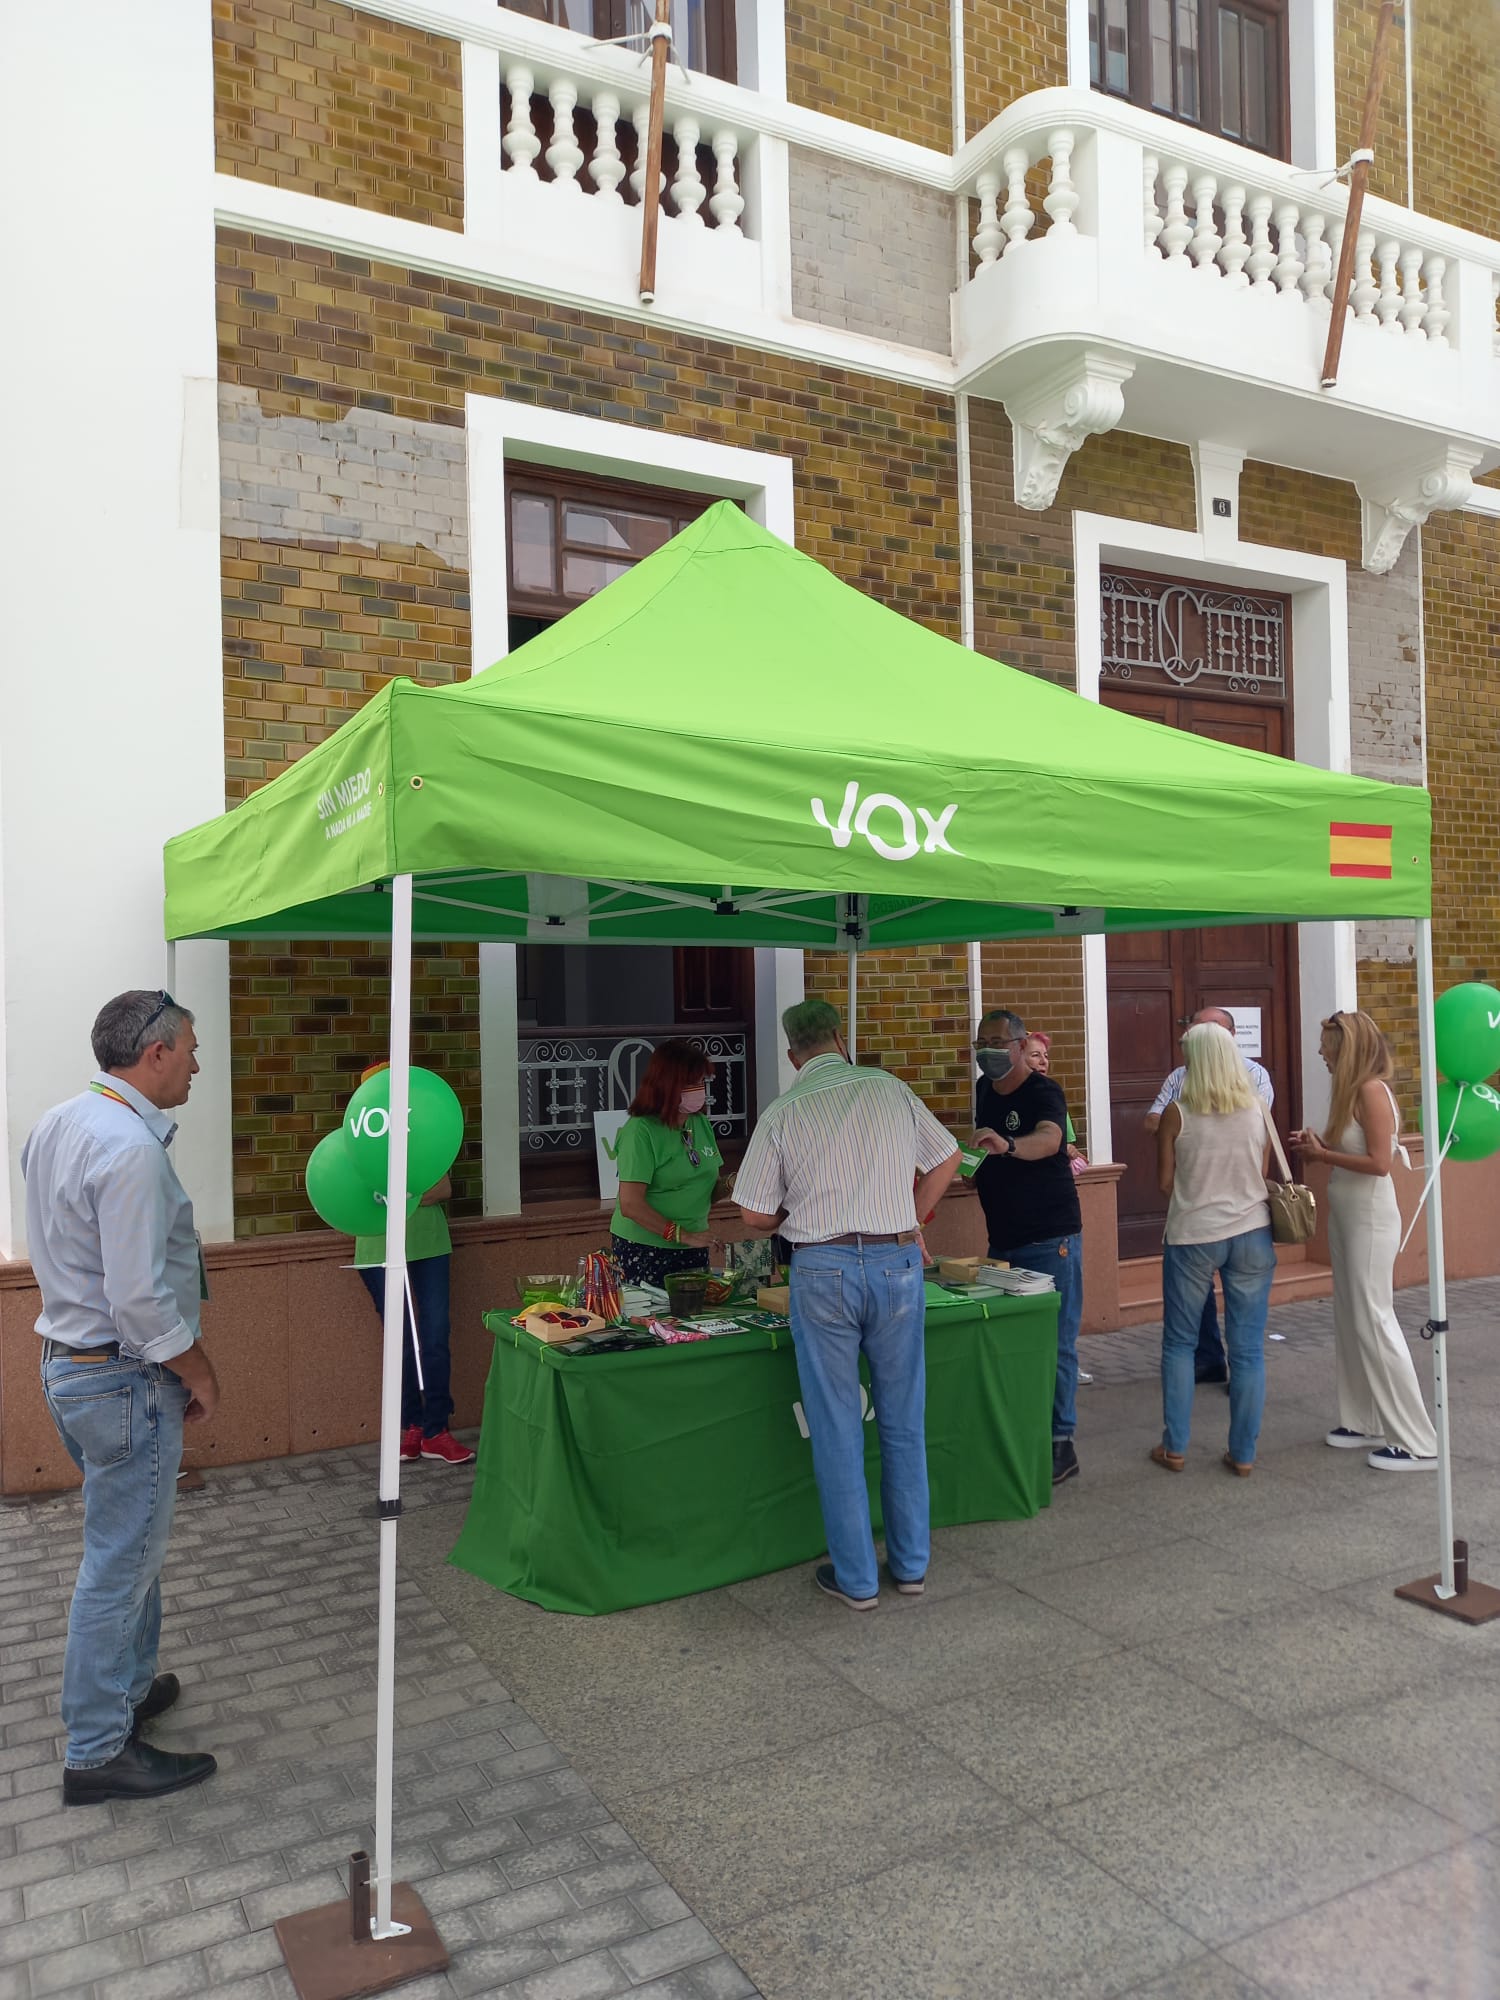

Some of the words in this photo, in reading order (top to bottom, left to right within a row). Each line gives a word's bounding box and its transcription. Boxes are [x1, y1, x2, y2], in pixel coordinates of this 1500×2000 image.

[317, 789, 338, 820] SIN
[333, 767, 371, 811] MIEDO
[811, 781, 966, 861] VOX
[1471, 1083, 1500, 1112] OX
[350, 1106, 412, 1138] VO
